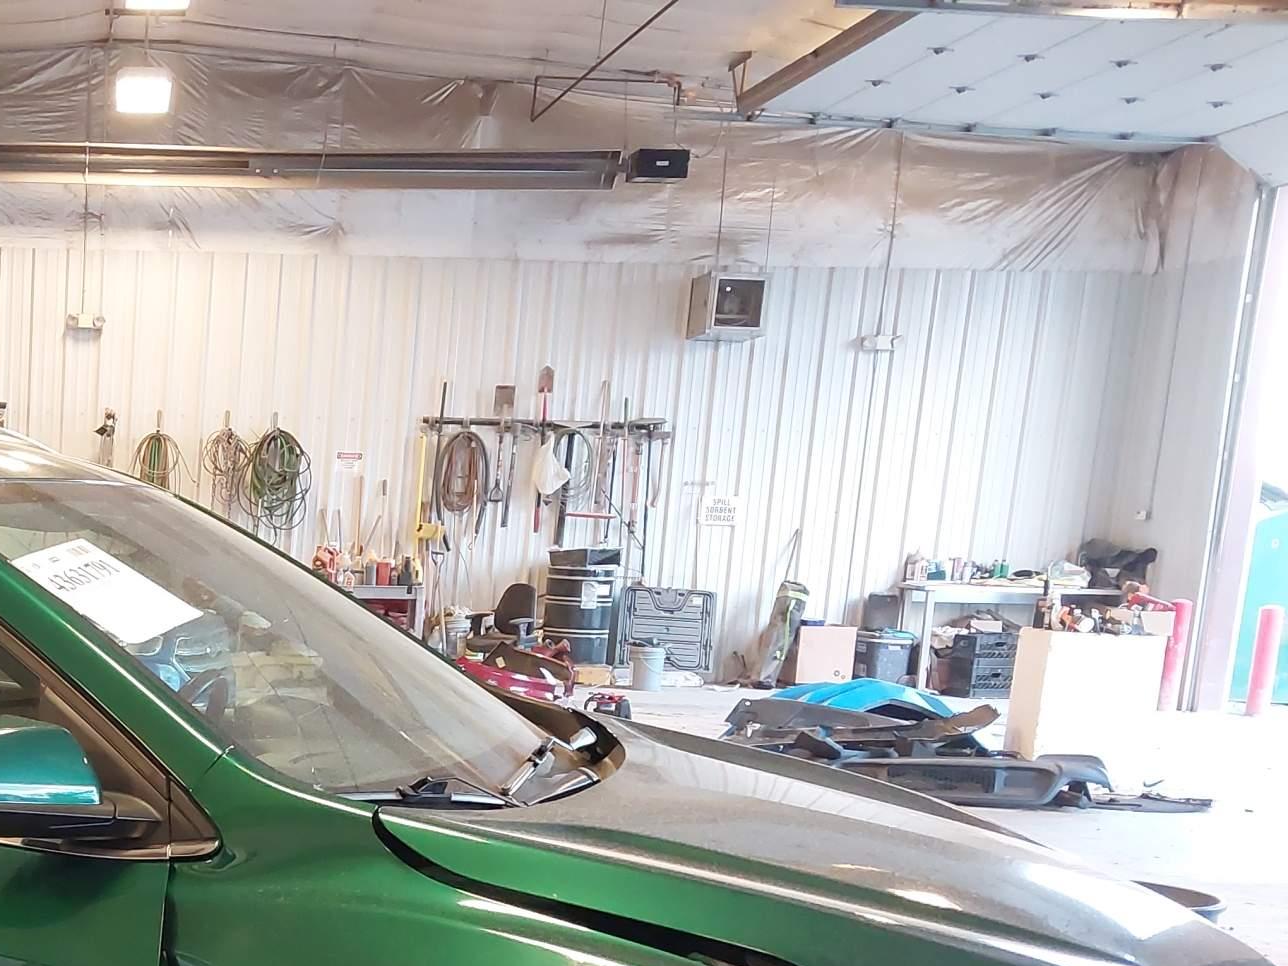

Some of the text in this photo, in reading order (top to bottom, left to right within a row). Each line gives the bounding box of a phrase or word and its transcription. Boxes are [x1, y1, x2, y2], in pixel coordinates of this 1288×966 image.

[713, 498, 730, 506] SPILL
[705, 514, 735, 522] STORAGE
[48, 559, 121, 592] 43631791
